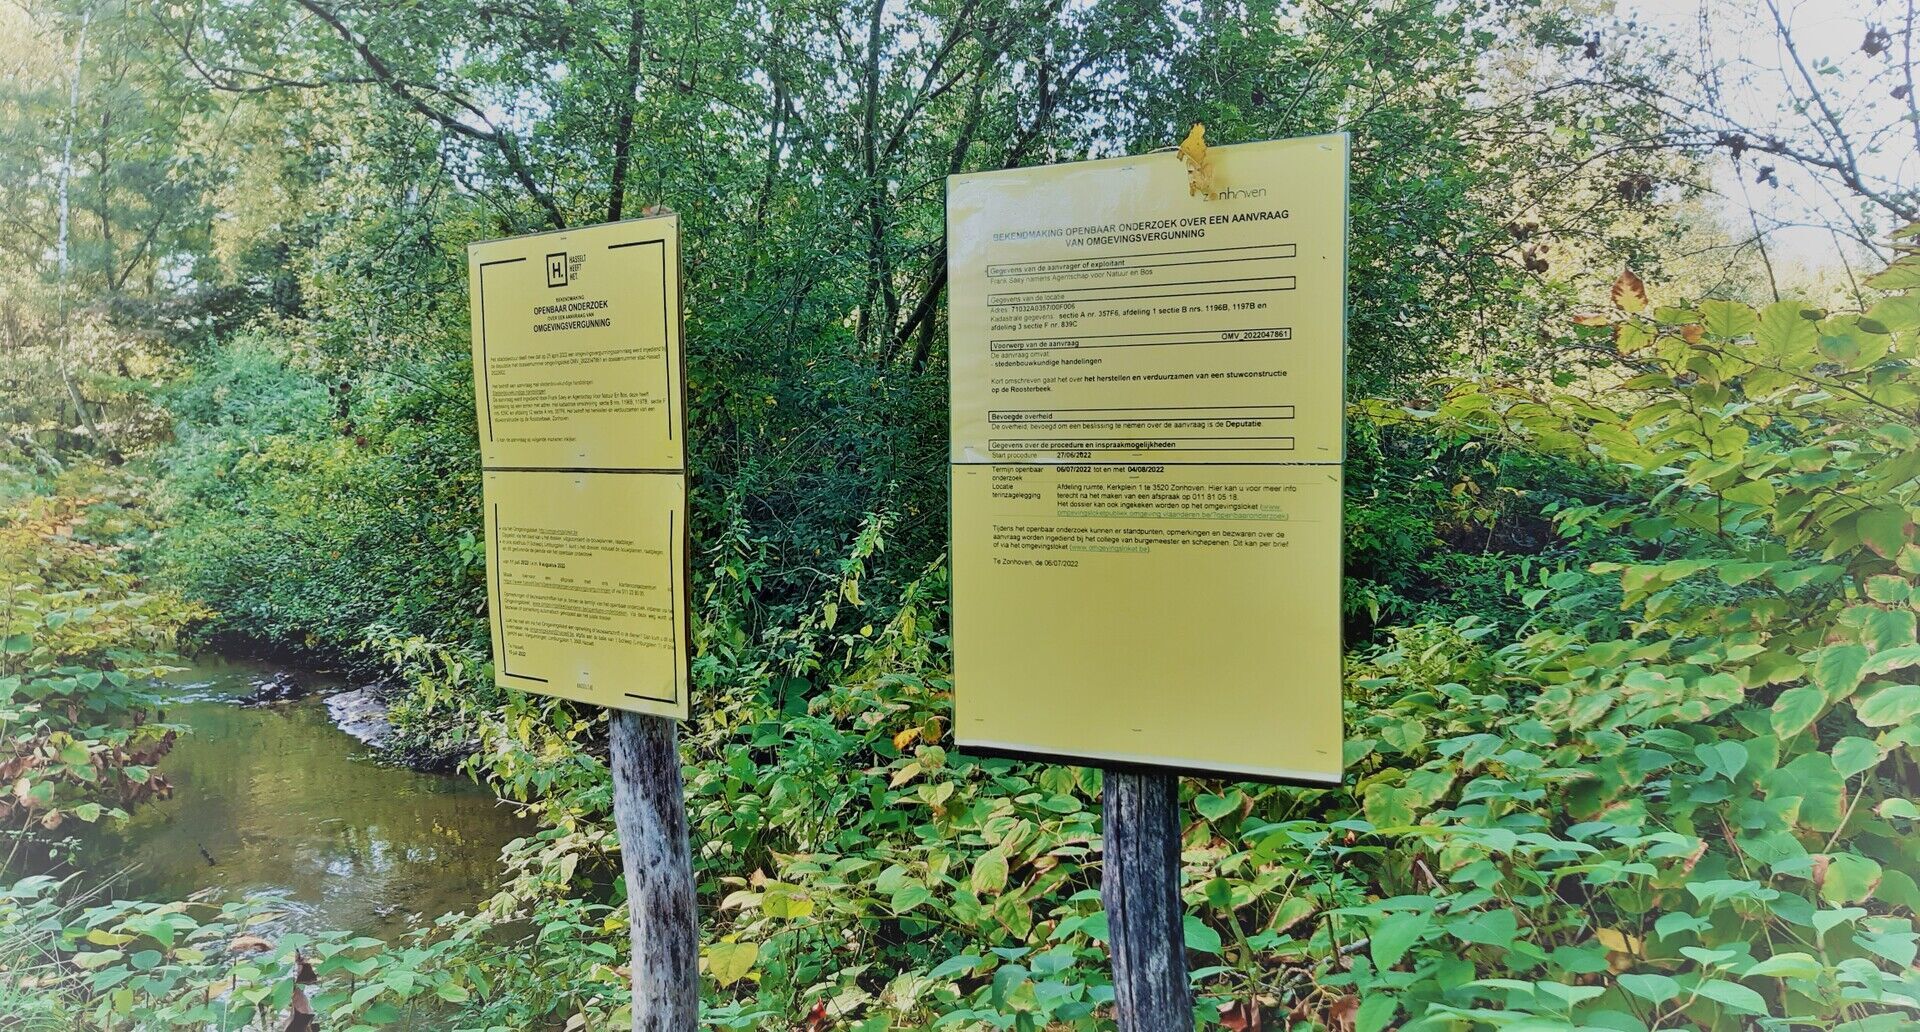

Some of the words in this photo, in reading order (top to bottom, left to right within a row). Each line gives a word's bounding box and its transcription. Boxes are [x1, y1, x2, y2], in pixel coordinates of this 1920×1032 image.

[992, 228, 1063, 242] BEKENDMAKING
[1065, 224, 1116, 236] OPENBAAR
[1118, 219, 1177, 232] ONDERZOEK
[1179, 216, 1207, 227] OVER
[1209, 215, 1229, 225] EEN
[1232, 210, 1289, 223] AANVRAAG
[1065, 238, 1084, 248] VAN
[1086, 229, 1205, 246] OMGEVINGSVERGUNNING
[569, 254, 586, 263] HASSELT
[990, 266, 1023, 276] Gegevens
[1048, 263, 1080, 272] aanvrager
[1090, 259, 1125, 269] exploitant
[1052, 272, 1089, 282] Agentschap
[534, 305, 567, 315] OPENBAAR
[568, 300, 608, 312] ONDERZOEK
[1122, 308, 1150, 317] afdeling
[534, 318, 610, 332] OMGEVINGSVERGUNNING
[990, 323, 1017, 332] afdeling
[1221, 332, 1288, 341] OMV_2022047861
[993, 342, 1024, 350] Voorwerp
[995, 358, 1060, 368] stedenbouwkundige
[1061, 357, 1102, 366] handelingen
[1226, 370, 1288, 378] stuwconstructie
[1082, 422, 1114, 430] beslissing
[992, 442, 1023, 450] Gegevens
[1050, 442, 1084, 450] procedure
[1095, 441, 1176, 449] inspraakmogelijkheden
[1120, 502, 1154, 510] ingekeken
[1026, 526, 1054, 534] openbaar
[1166, 529, 1210, 538] opmerkingen
[1046, 535, 1075, 543] ingediend
[1096, 536, 1120, 544] college
[1134, 537, 1180, 546] burgemeester
[1021, 542, 1068, 551] omgevingsloket
